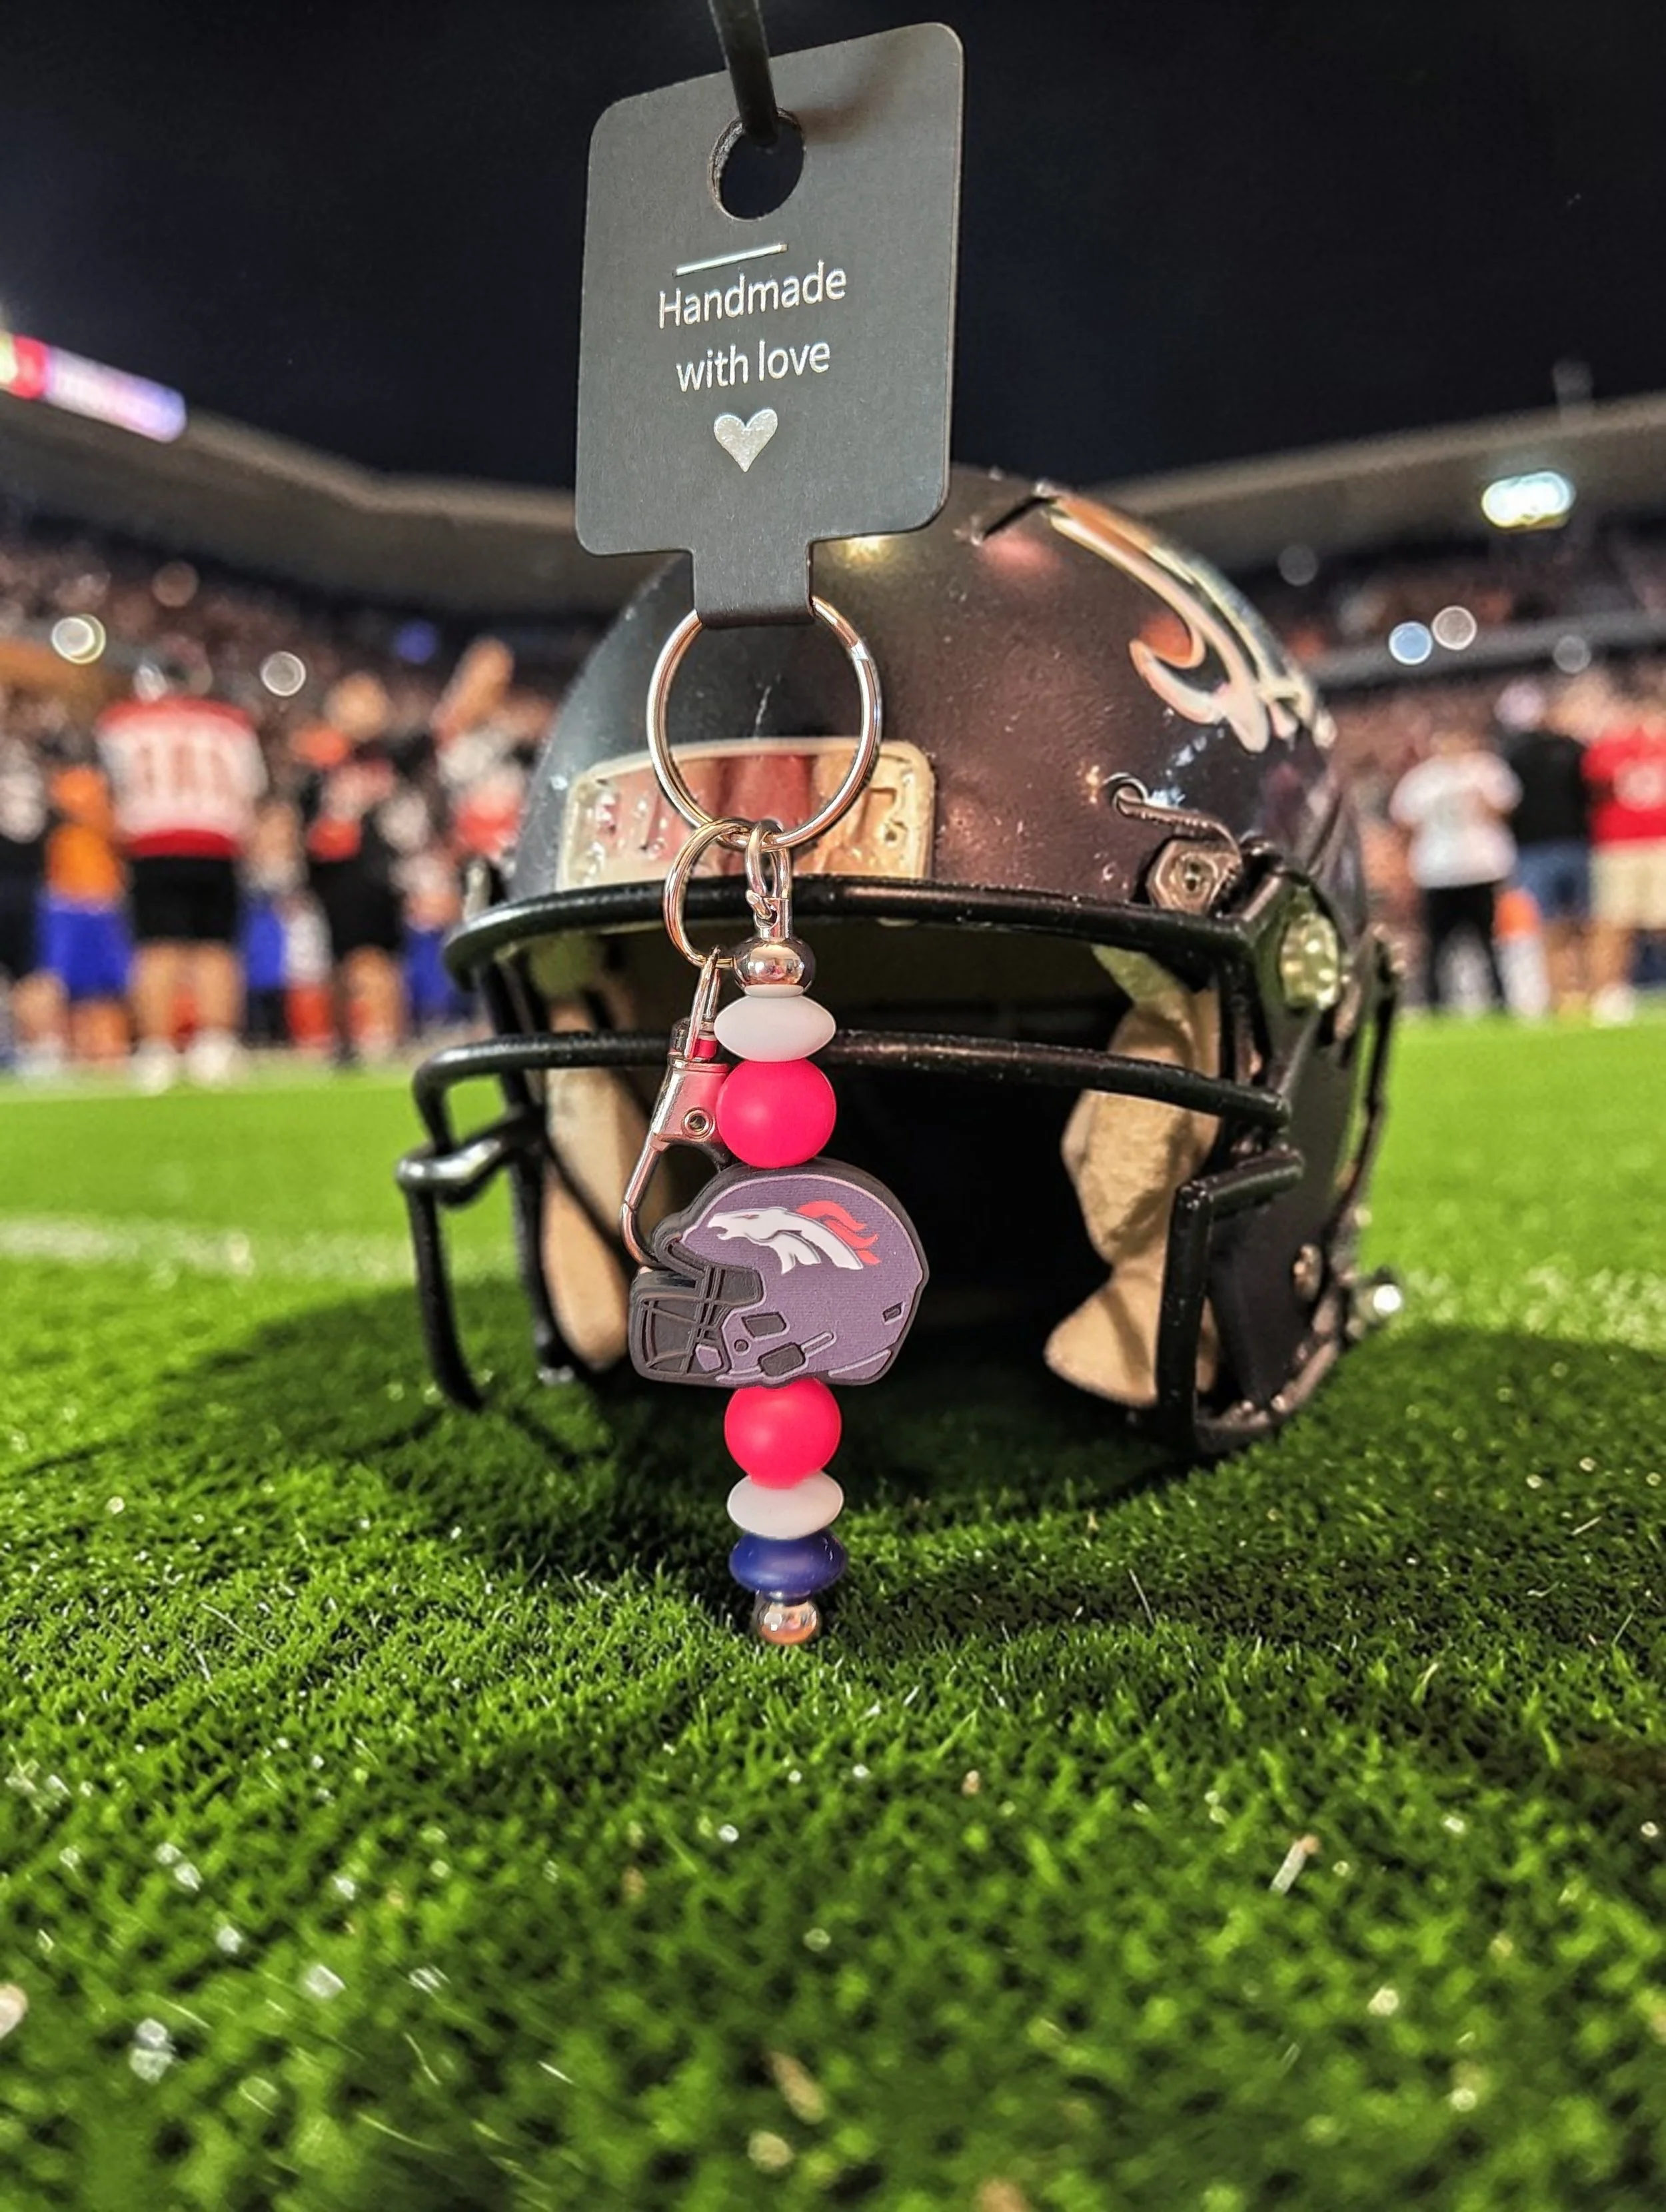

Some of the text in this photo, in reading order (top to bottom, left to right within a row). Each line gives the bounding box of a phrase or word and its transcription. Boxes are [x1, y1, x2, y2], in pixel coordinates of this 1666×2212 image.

[658, 259, 847, 329] Handmade
[676, 338, 831, 392] with love
